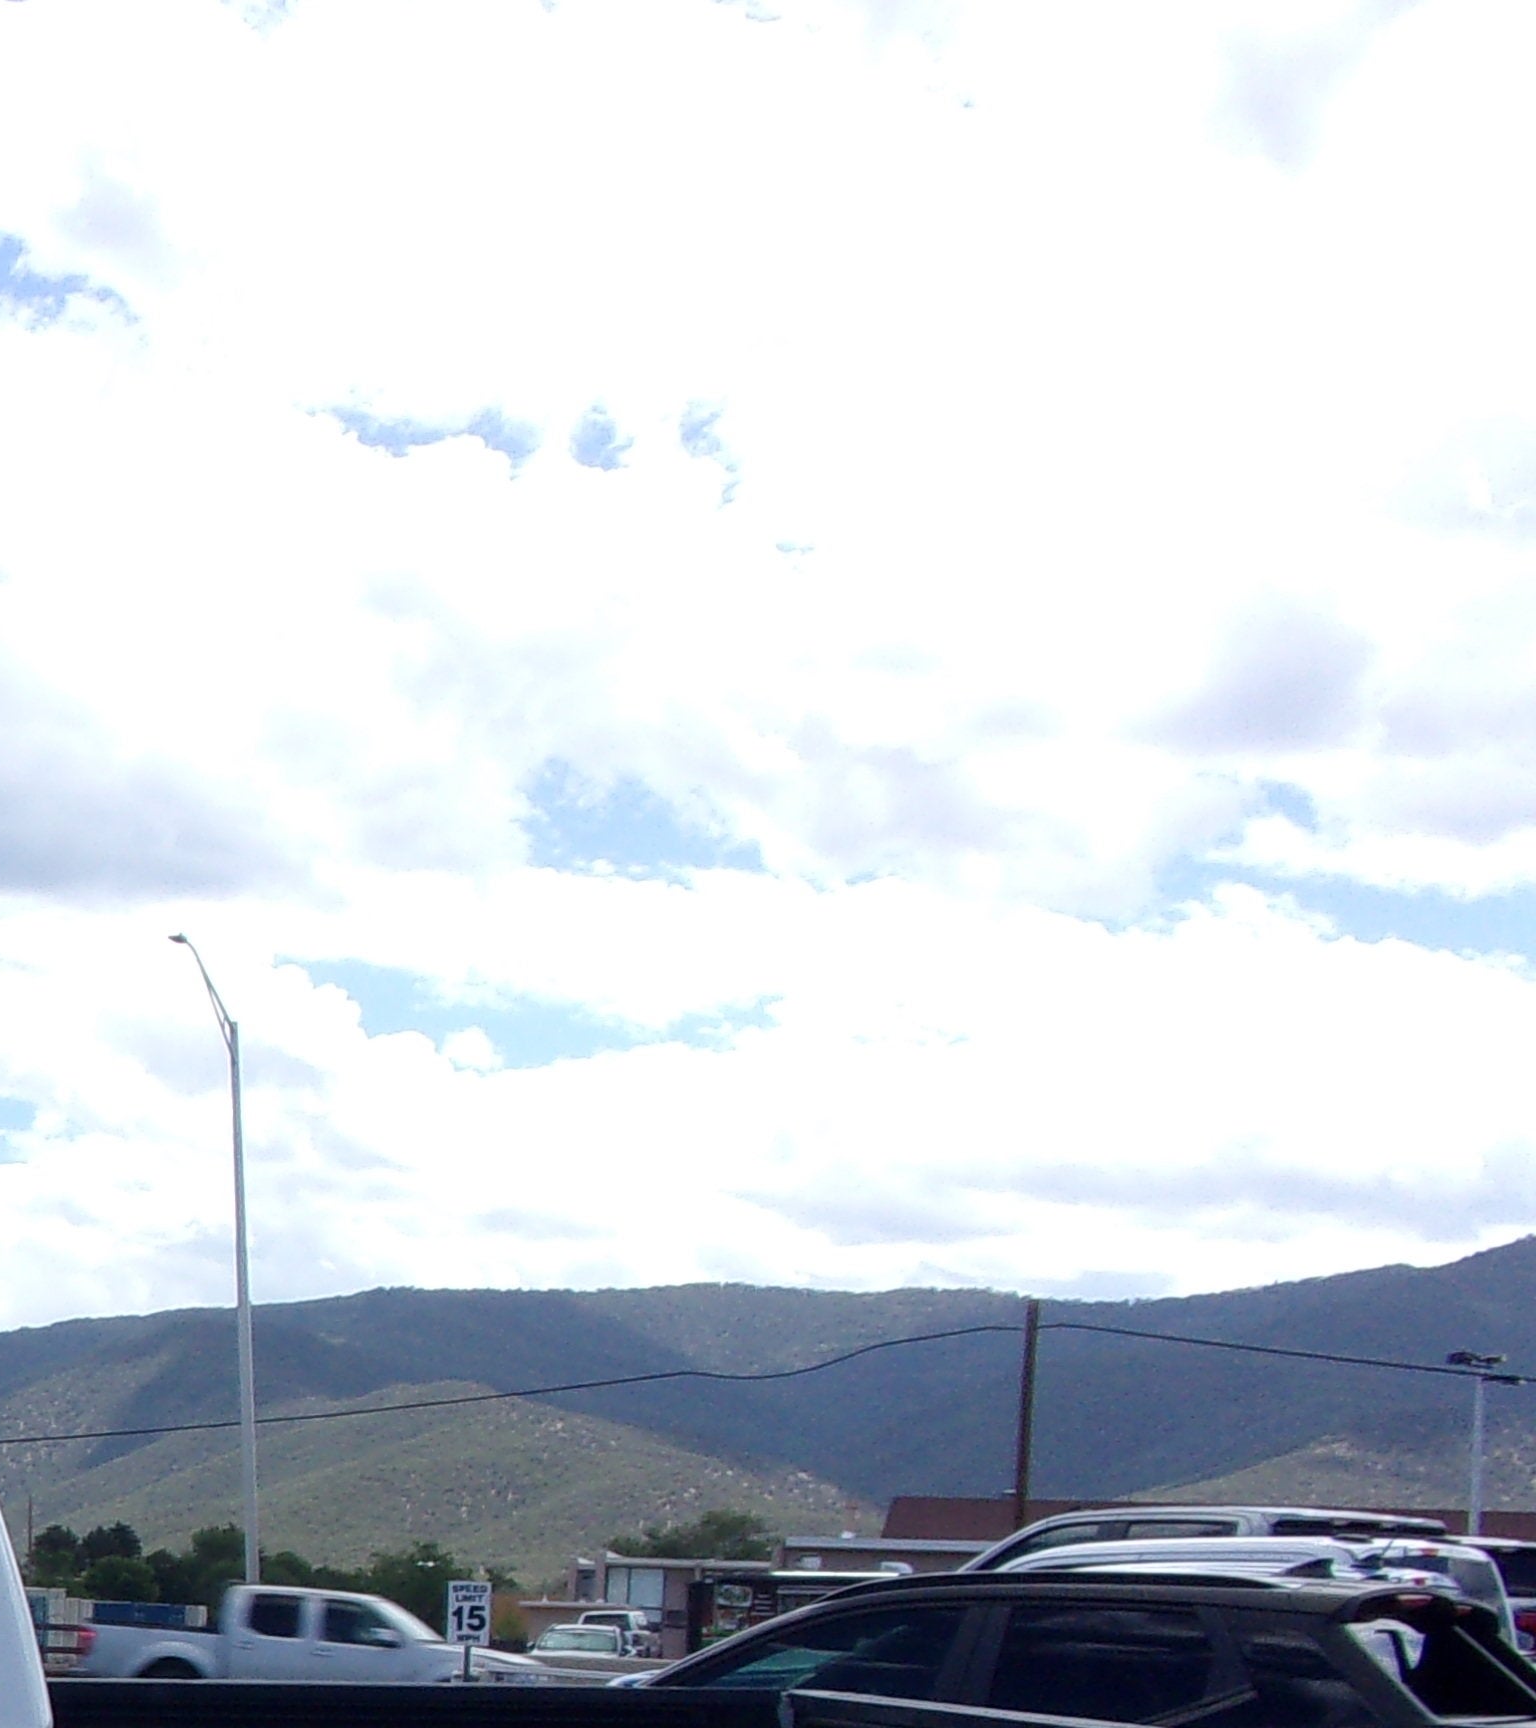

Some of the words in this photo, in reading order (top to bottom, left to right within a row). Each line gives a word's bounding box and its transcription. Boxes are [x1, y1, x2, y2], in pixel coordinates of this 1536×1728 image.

[452, 1584, 488, 1593] SPEED
[455, 1594, 484, 1602] LIMIT
[451, 1605, 486, 1632] 15
